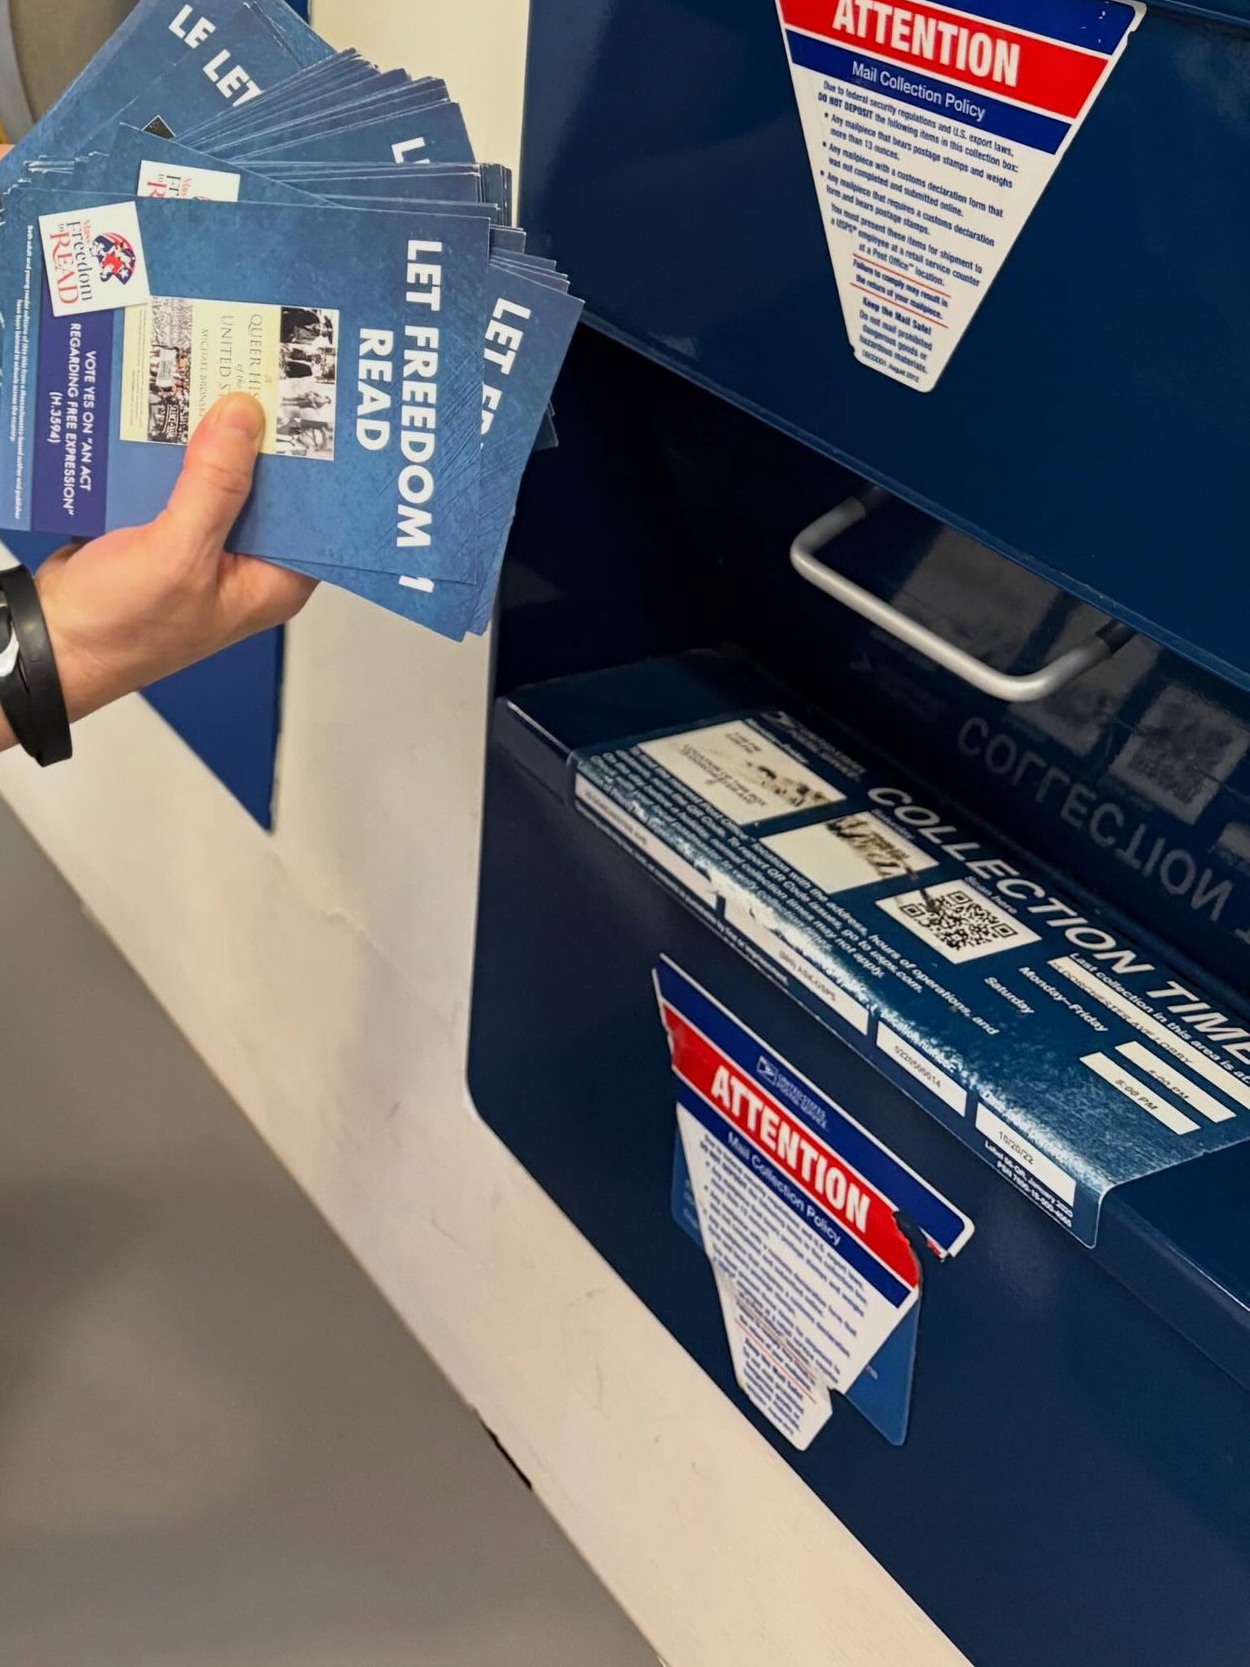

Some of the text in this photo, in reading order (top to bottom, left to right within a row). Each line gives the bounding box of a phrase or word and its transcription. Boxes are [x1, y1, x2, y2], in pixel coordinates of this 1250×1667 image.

[822, 79, 1014, 158] Due to federal security regulations and U.S. export laws,
[851, 59, 986, 123] Mail Collection Policy
[816, 90, 1019, 173] DO NOT DEPOSIT the following items in this collection box:
[49, 231, 80, 304] READ
[66, 220, 93, 301] Freedom
[219, 316, 234, 378] UNITED
[248, 314, 263, 367] QUEER
[483, 297, 532, 376] LET
[46, 390, 63, 443] (H.3594)
[62, 322, 82, 516] REGARDING FREE EXPRESSION"
[78, 349, 97, 491] VOTE YES ON "AN ACT
[356, 328, 394, 451] READ
[396, 239, 443, 547] LET FREEDOM
[867, 786, 1155, 974] COLLECTION
[808, 887, 828, 902] the
[825, 901, 868, 936] address,
[867, 933, 901, 960] hours
[898, 958, 917, 969] of
[911, 967, 971, 1017] operations,
[970, 1015, 1000, 1035] and
[839, 928, 923, 994] go to usps.com.
[983, 975, 1035, 1014] Saturday
[1017, 965, 1109, 1032] Monday–Friday
[1068, 951, 1098, 972] Last
[1094, 970, 1154, 1013] collection
[1151, 1011, 1168, 1023] in
[1165, 1021, 1192, 1040] this
[1189, 1039, 1221, 1061] area
[1218, 1059, 1235, 1071] is
[1136, 1095, 1159, 1110] PM
[710, 1064, 871, 1233] ATTENTION
[998, 1130, 1034, 1165] 10/20/22
[727, 1130, 841, 1246] Mail Collection Policy
